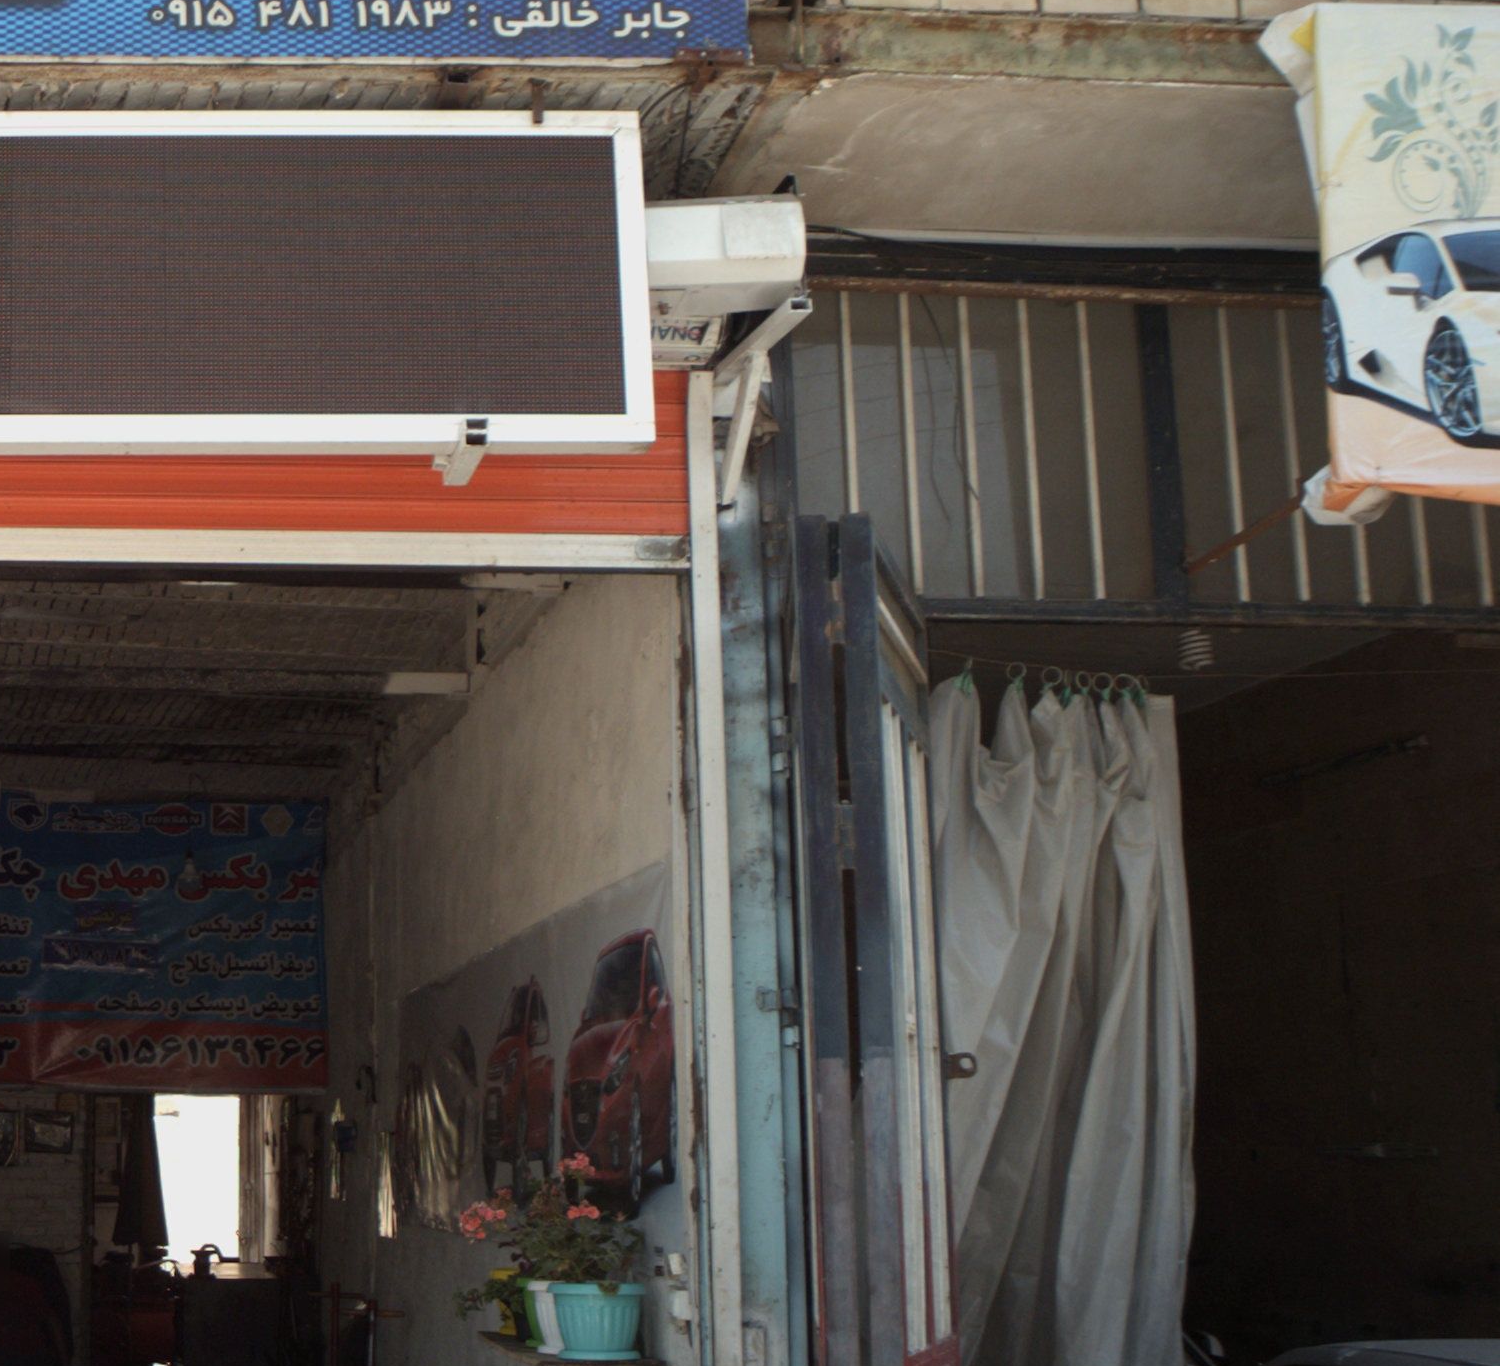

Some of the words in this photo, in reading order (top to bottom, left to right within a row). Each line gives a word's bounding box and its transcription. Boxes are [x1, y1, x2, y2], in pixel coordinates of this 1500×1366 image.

[493, 0, 600, 37] خالقی
[613, 1, 691, 39] جابر
[59, 860, 167, 899] مهدی
[98, 992, 163, 1014] صفحه
[186, 993, 247, 1017] دیسک
[253, 994, 320, 1018] تعویض
